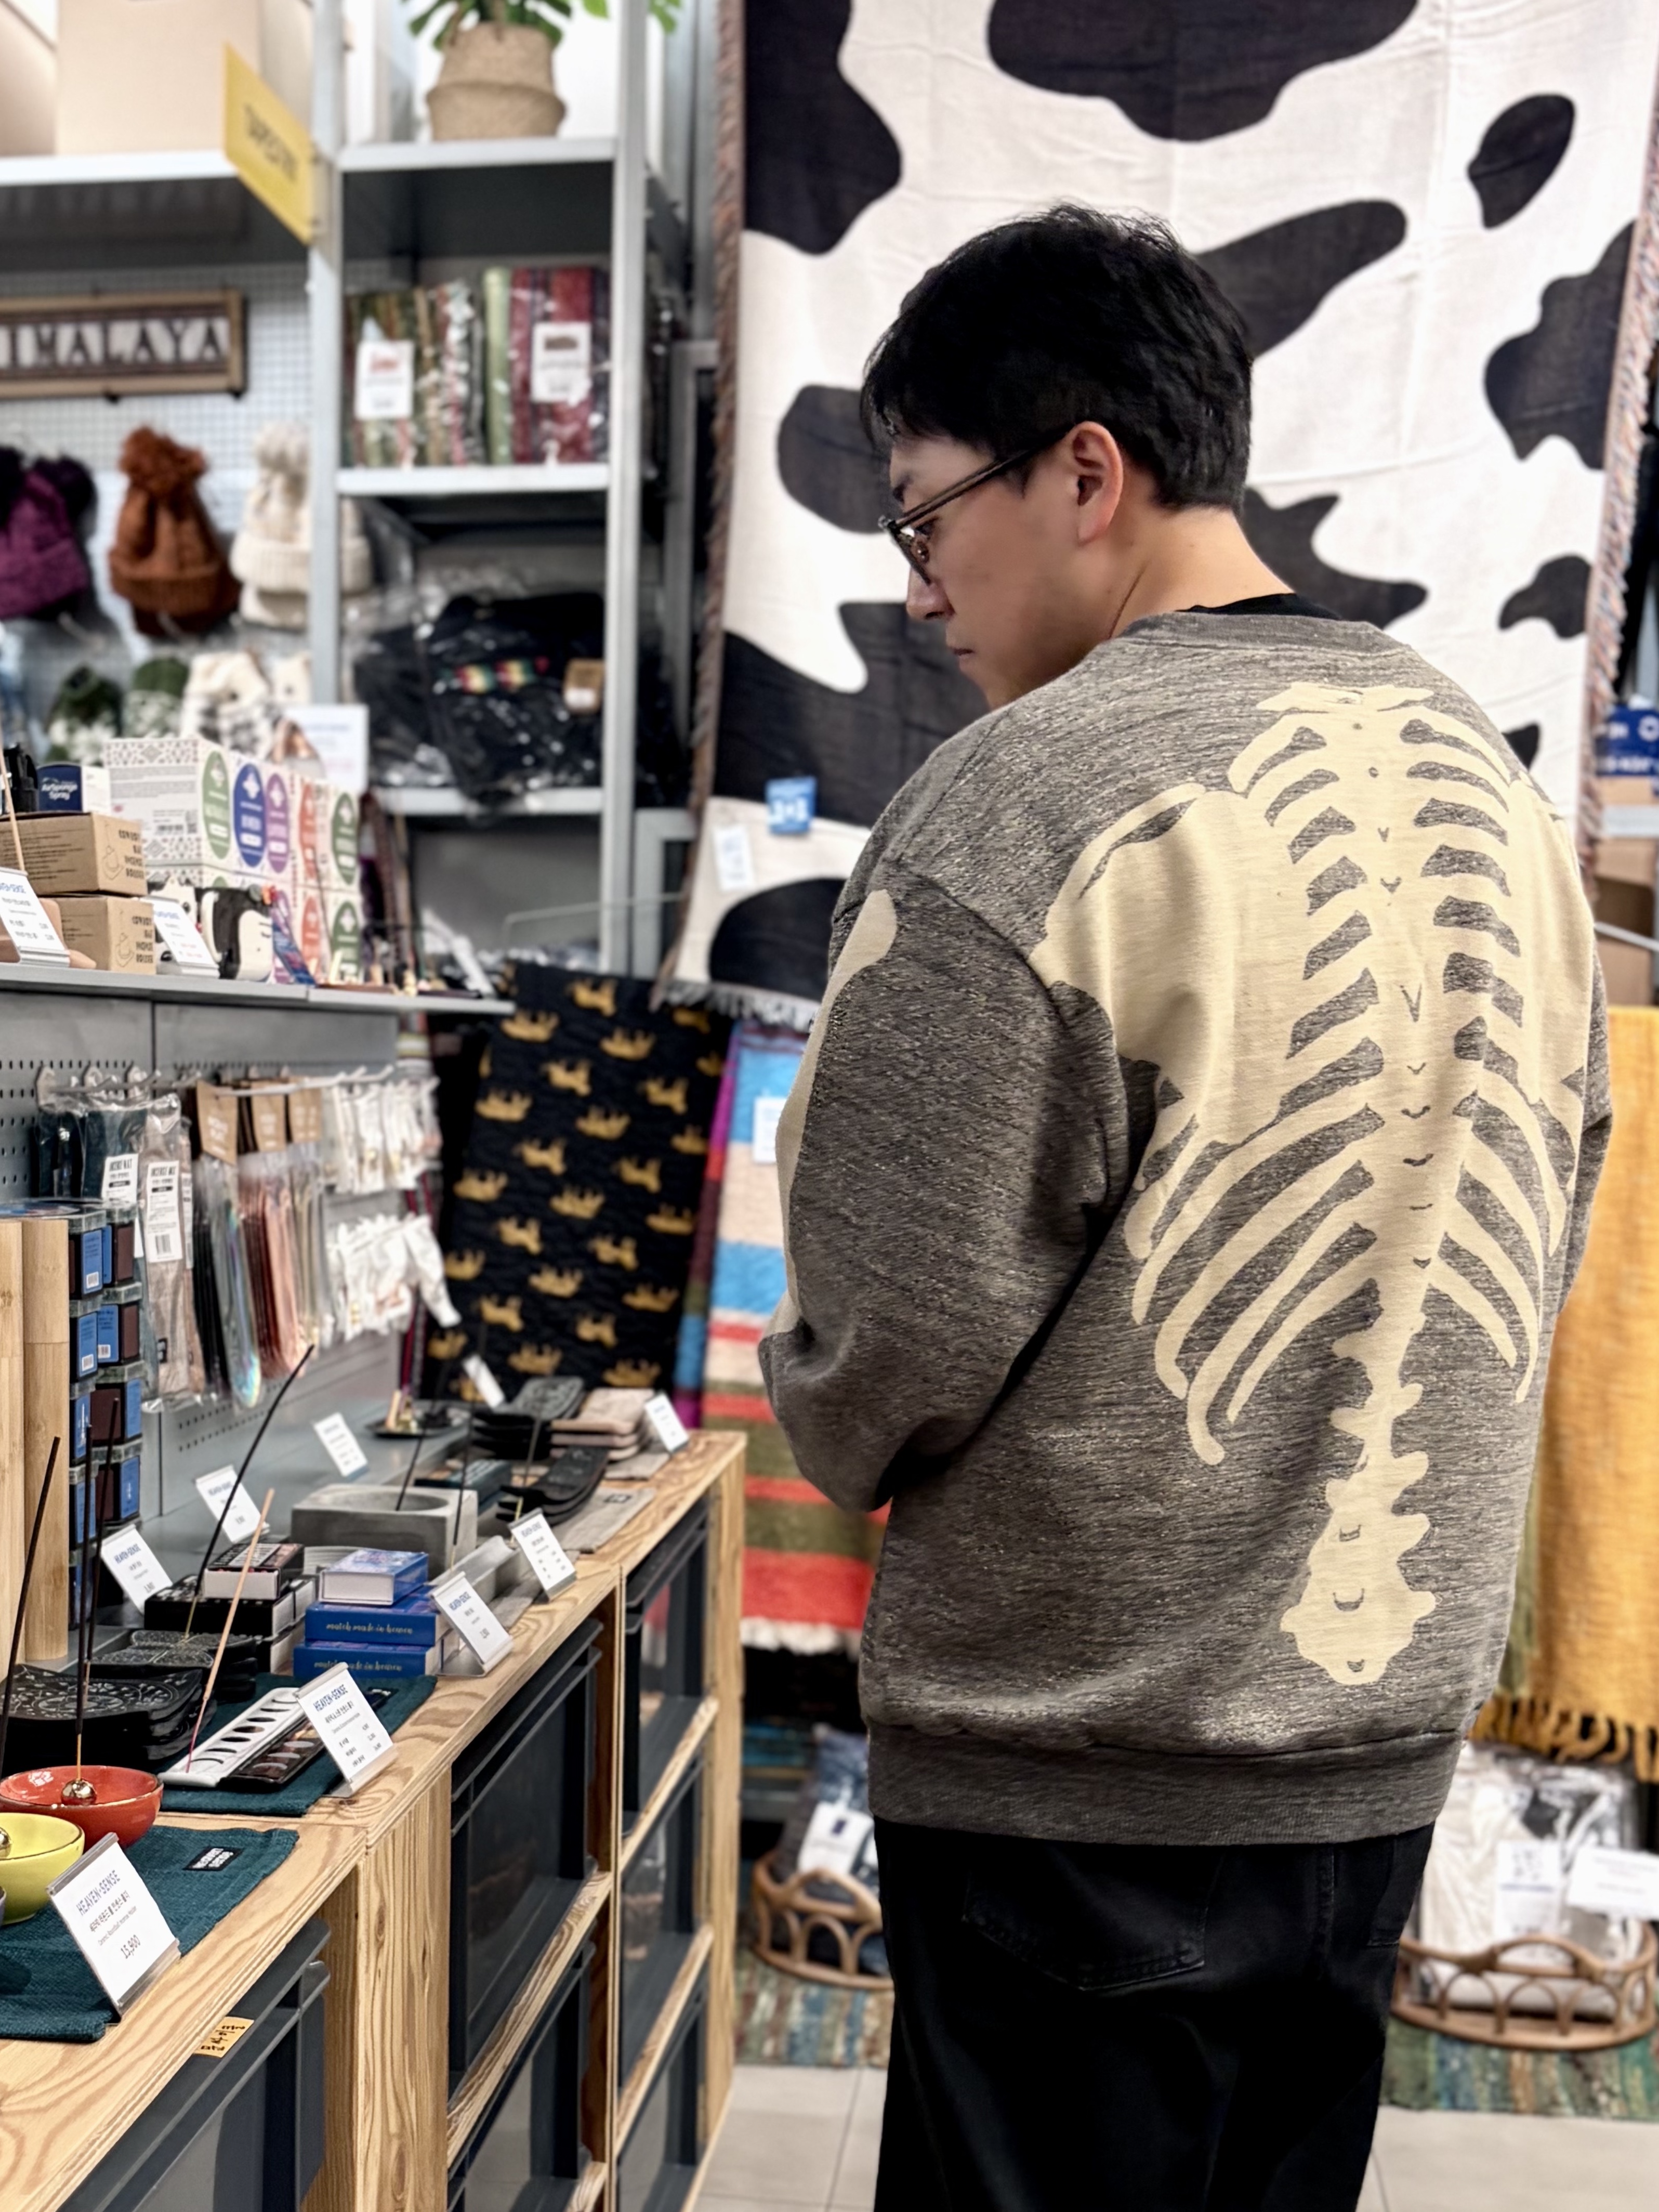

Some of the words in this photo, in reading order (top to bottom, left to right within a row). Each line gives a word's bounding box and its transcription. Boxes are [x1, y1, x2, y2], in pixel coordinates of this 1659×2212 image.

[326, 1621, 351, 1632] match
[352, 1622, 374, 1632] made
[376, 1624, 385, 1632] in
[121, 1934, 141, 1959] 15,900
